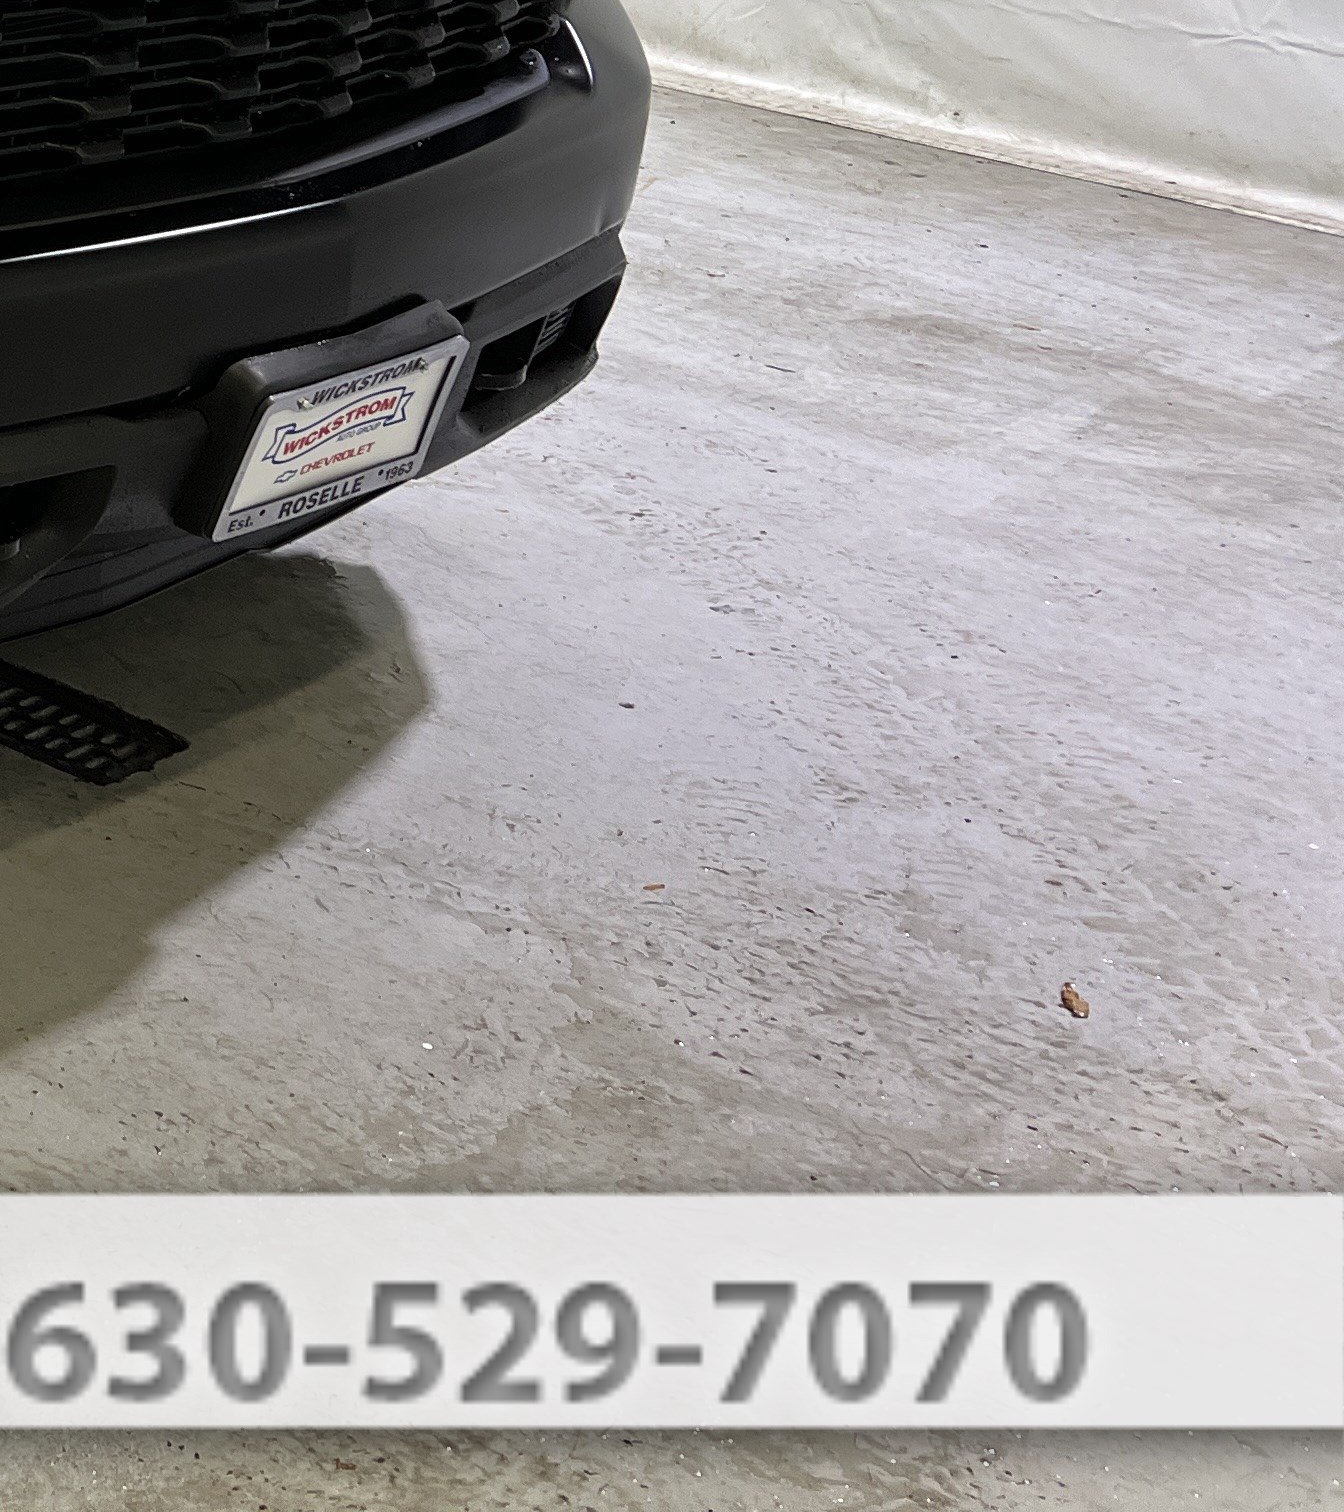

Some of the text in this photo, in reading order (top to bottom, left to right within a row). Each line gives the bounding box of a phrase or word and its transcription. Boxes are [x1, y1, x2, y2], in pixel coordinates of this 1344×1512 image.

[311, 356, 425, 406] WICKSTROM
[283, 396, 397, 456] WICKSTROM
[299, 441, 376, 476] CHEVROLET
[227, 516, 254, 534] Est.
[277, 475, 364, 520] ROSELLE
